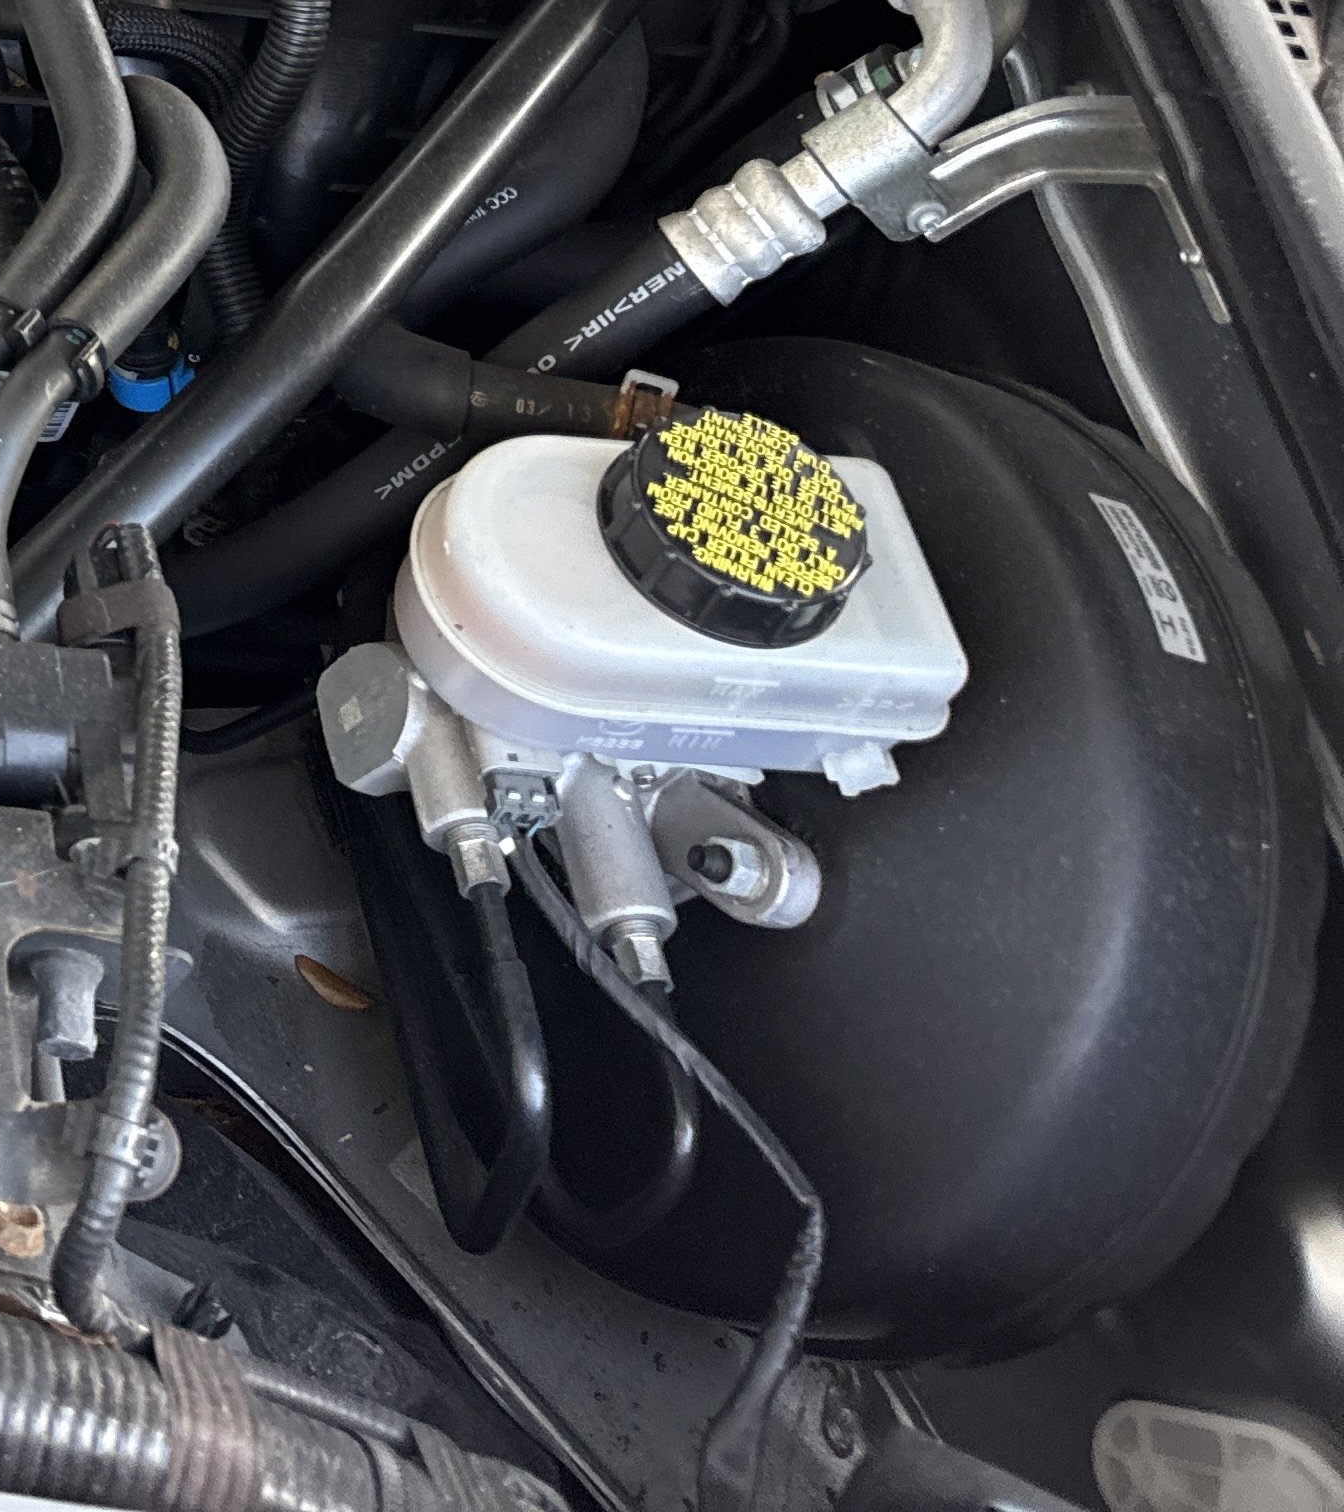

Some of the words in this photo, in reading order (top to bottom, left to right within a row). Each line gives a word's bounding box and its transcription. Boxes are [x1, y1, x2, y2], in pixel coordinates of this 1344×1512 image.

[669, 423, 731, 456] LIQUIDE
[691, 418, 788, 467] PROVENANT
[700, 412, 793, 456] CONTENANT
[738, 414, 799, 446] SCELLE
[667, 444, 742, 487] BOUCHON
[759, 458, 794, 484] QUE
[795, 450, 831, 475] D'UN
[647, 482, 694, 511] FROM
[797, 476, 857, 515] PLOYER
[810, 468, 842, 493] DOT
[654, 497, 686, 523] USE
[665, 474, 753, 521] CONTAINER.
[769, 489, 855, 537] NETTOYER
[818, 498, 864, 530] AVANT
[667, 522, 700, 544] CAP
[697, 502, 743, 532] FLUID
[756, 514, 820, 552] SEALED
[703, 535, 760, 570] FILLER
[767, 532, 802, 558] DOT
[762, 562, 817, 596] CLEAN
[771, 550, 837, 591] BEFORE
[801, 548, 845, 581] ONLY
